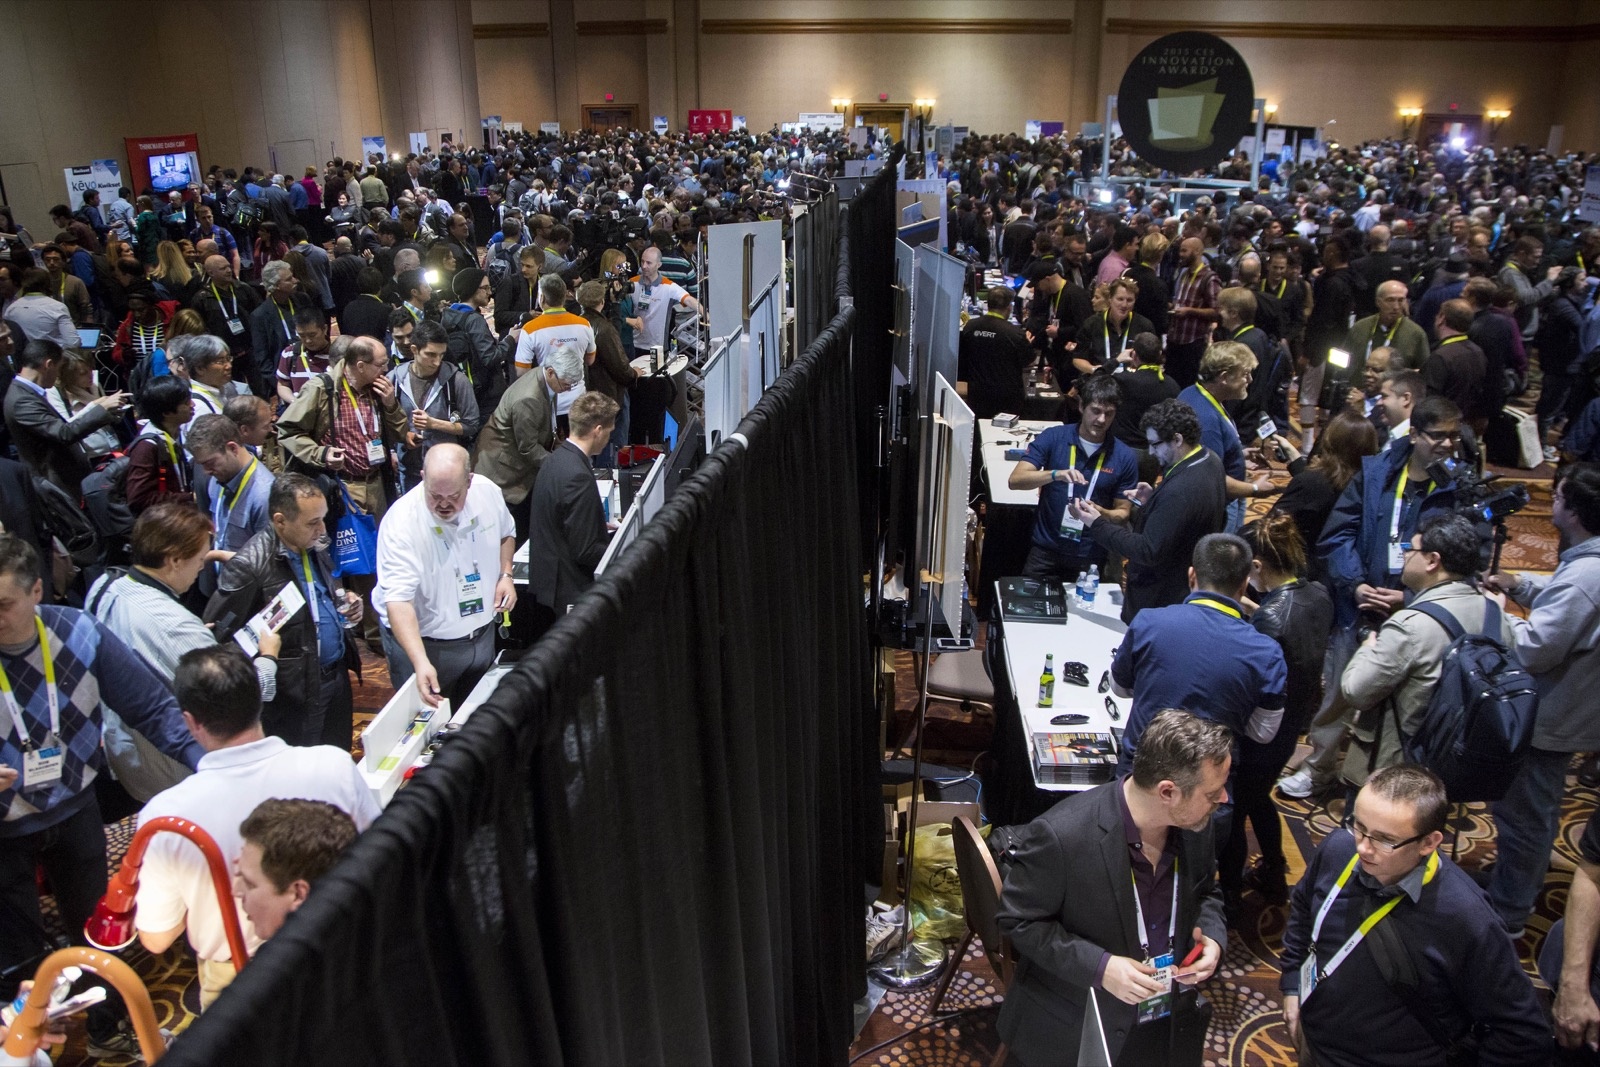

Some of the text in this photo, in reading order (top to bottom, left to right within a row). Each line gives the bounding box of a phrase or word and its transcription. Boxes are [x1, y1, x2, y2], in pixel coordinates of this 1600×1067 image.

[1163, 48, 1215, 56] 2015 CES
[1142, 56, 1235, 66] INNOVATION
[1158, 66, 1217, 75] AWARDS
